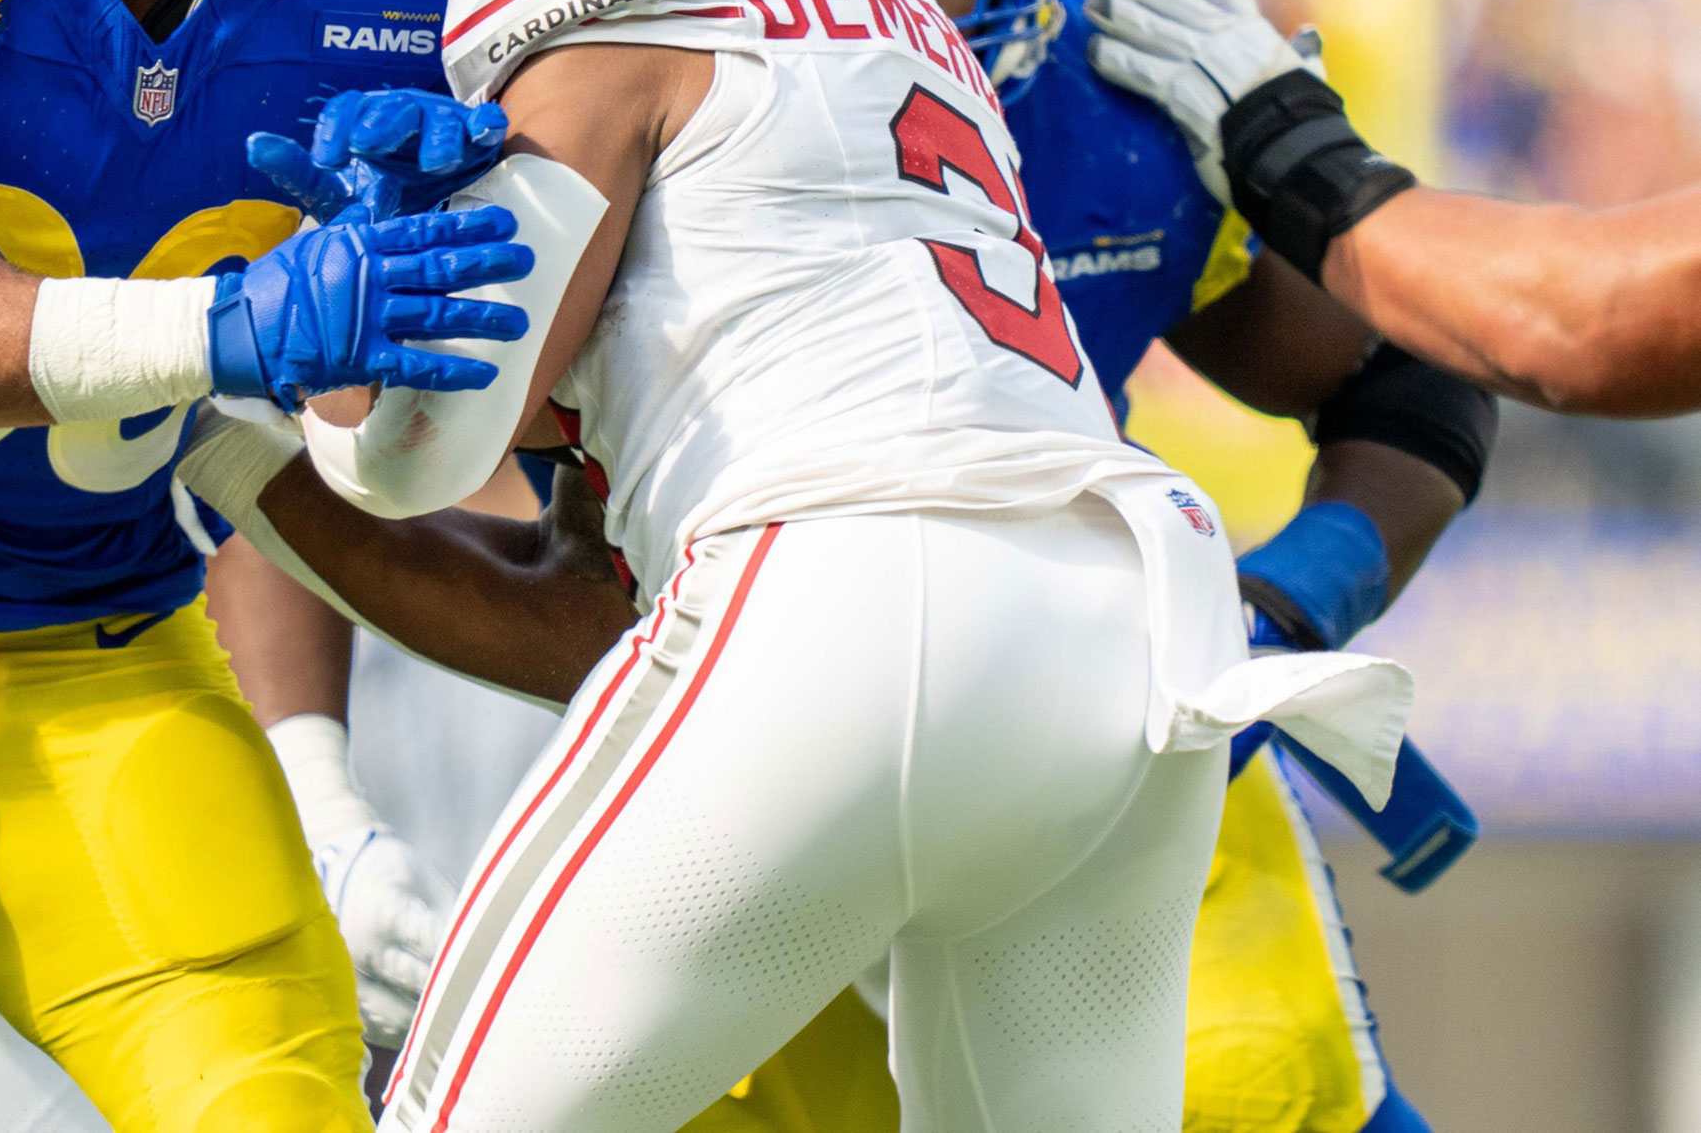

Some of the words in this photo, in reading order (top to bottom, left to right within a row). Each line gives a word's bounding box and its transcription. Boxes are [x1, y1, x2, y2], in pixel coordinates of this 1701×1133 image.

[322, 24, 436, 55] RAMS
[140, 90, 169, 115] NFL
[889, 81, 1085, 391] 3
